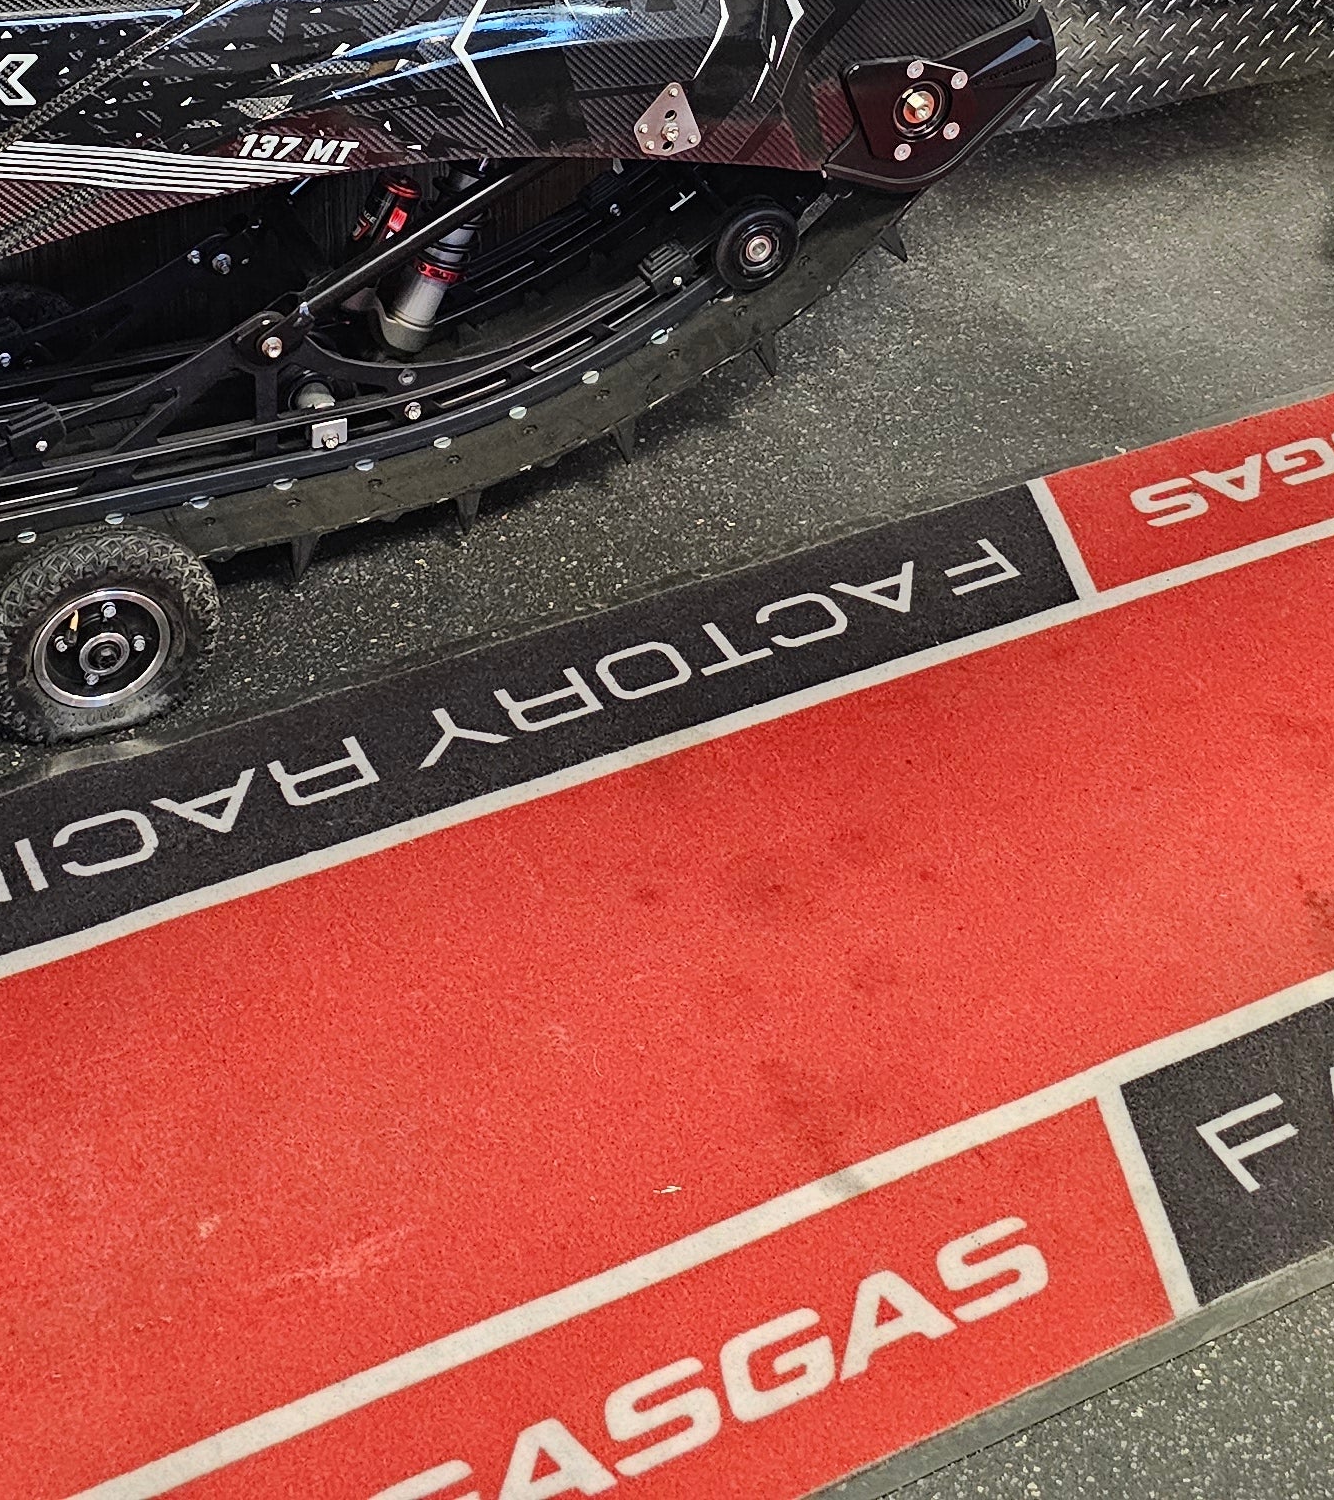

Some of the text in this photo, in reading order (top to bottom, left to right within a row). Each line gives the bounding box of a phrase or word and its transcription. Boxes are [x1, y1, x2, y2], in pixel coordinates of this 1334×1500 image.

[238, 132, 360, 165] 137 MT
[417, 538, 1020, 768] FACTORY
